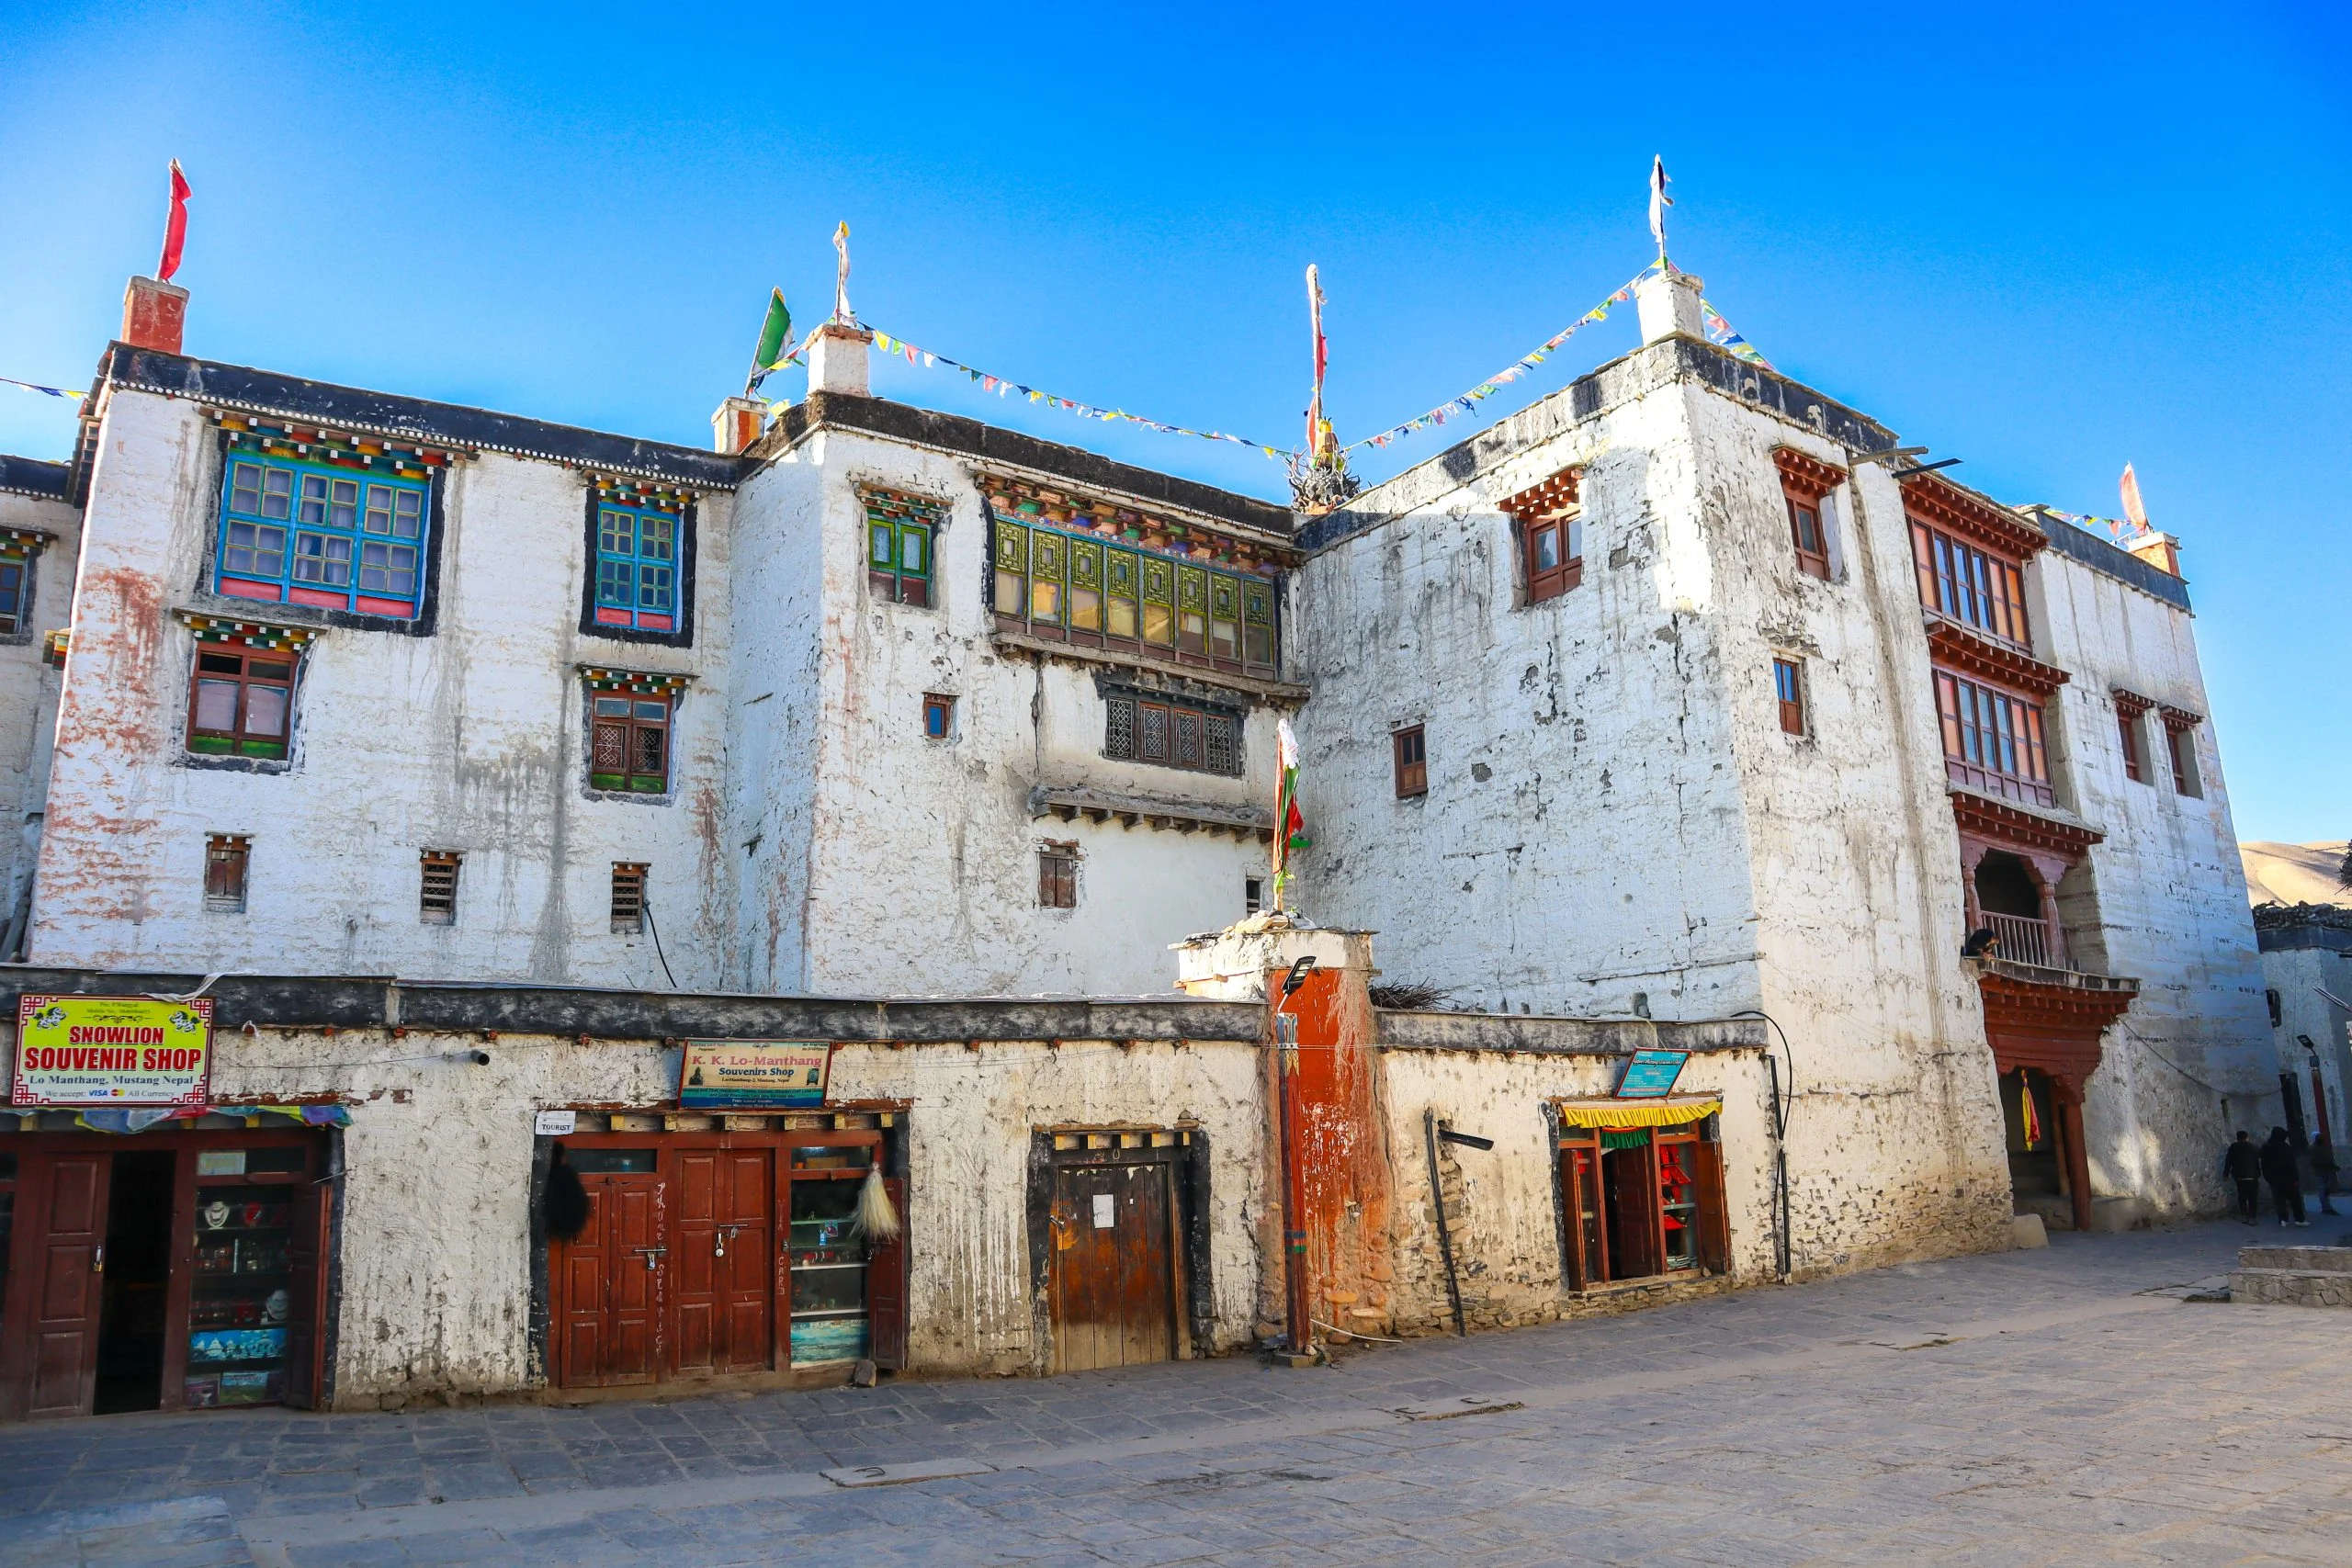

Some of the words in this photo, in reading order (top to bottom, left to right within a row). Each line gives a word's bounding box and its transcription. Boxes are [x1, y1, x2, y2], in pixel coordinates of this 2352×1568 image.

[69, 1026, 164, 1044] SNOWLION
[24, 1047, 137, 1071] SOUVENIR
[142, 1048, 201, 1071] SHOP
[691, 1055, 707, 1065] K.
[711, 1055, 725, 1065] K.
[729, 1055, 822, 1067] Lo-Manthang
[718, 1066, 767, 1076] Souvenirs
[769, 1066, 795, 1077] Shop
[30, 1076, 45, 1084] Lo
[112, 1076, 160, 1086] Mustang
[163, 1076, 193, 1086] Nepal
[141, 1090, 175, 1099] Currency
